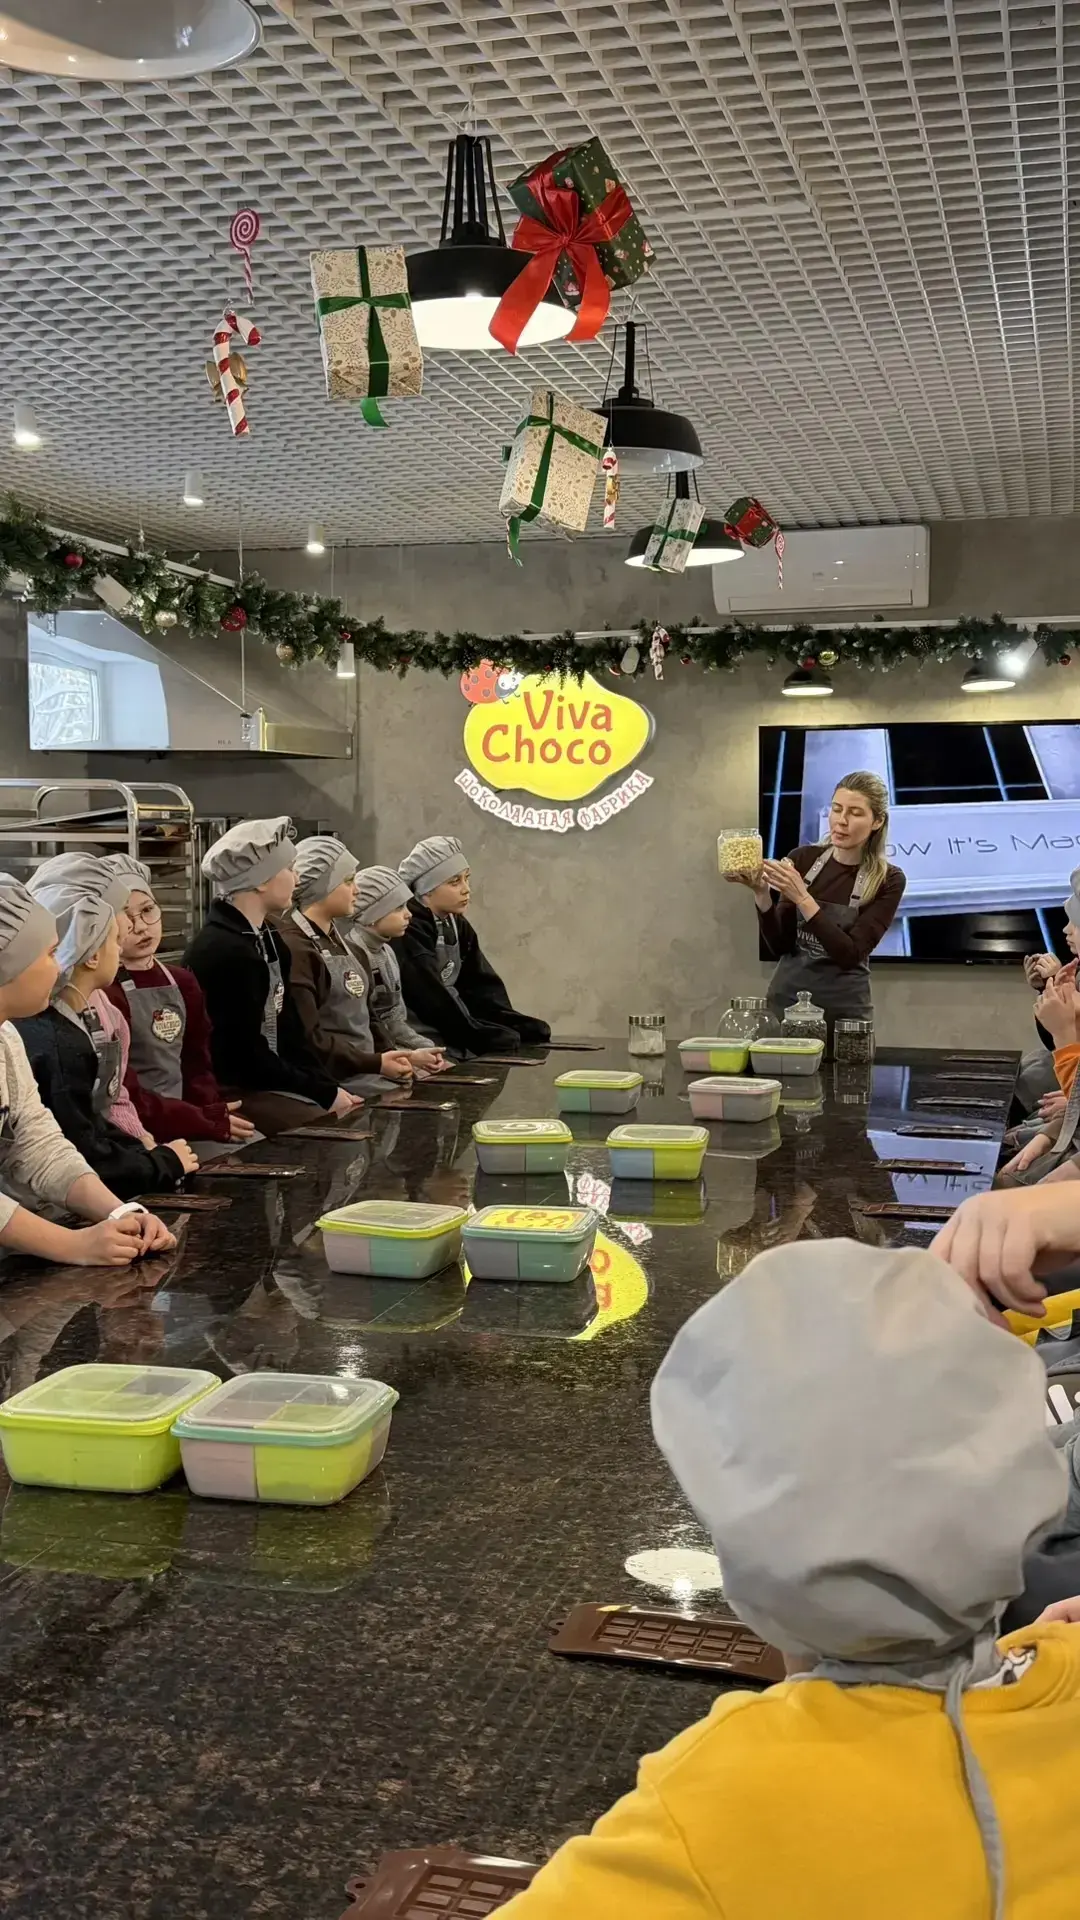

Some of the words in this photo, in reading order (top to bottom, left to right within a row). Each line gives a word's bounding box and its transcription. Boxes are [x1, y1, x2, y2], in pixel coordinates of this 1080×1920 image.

[523, 690, 613, 732] Viva
[481, 724, 612, 765] Choco
[456, 770, 574, 830] ШОКОЛАДНАЯ
[579, 771, 651, 829] ФАБРИКА
[884, 842, 932, 856] ow
[948, 837, 998, 855] It's
